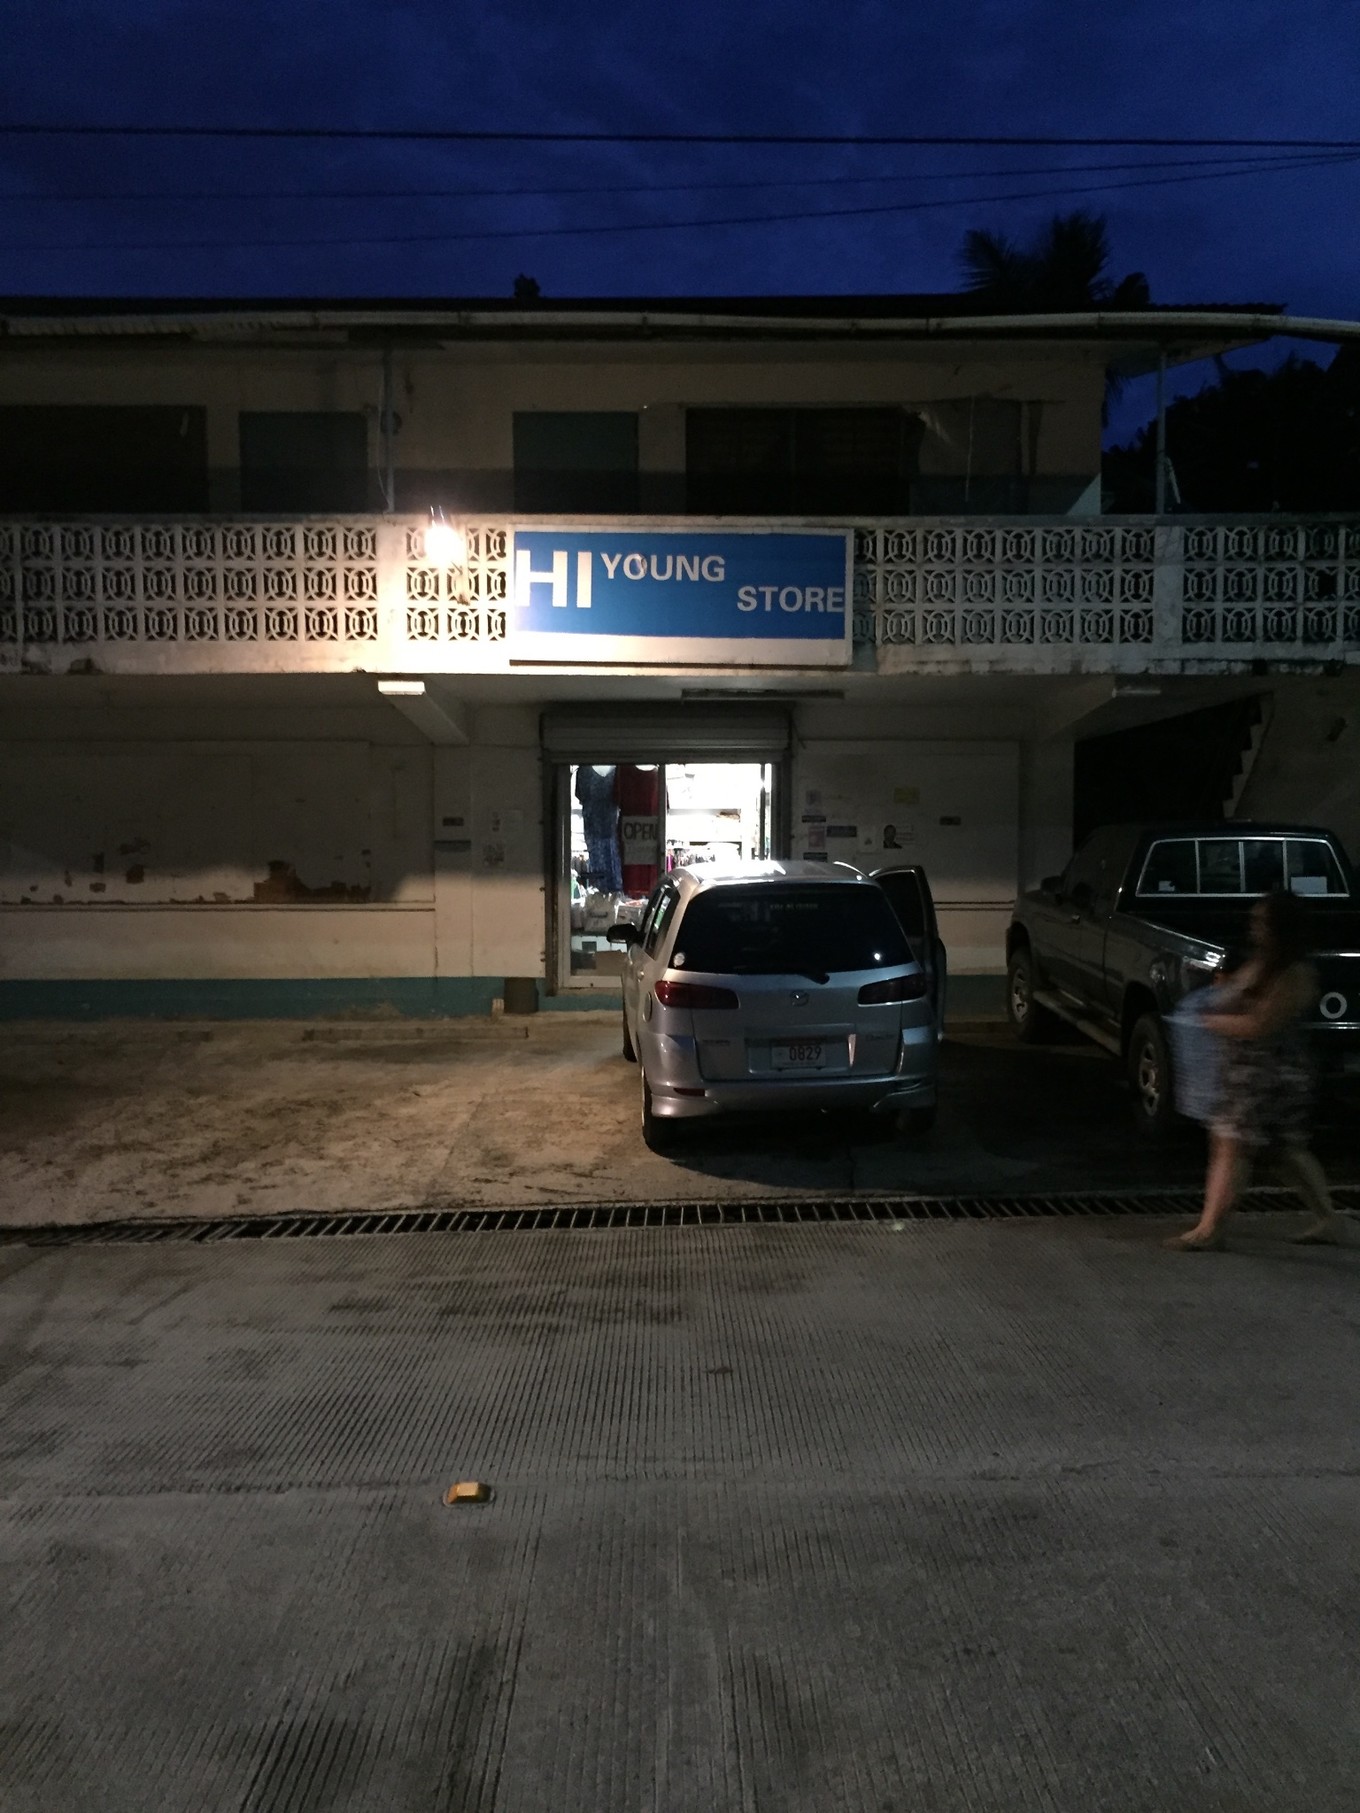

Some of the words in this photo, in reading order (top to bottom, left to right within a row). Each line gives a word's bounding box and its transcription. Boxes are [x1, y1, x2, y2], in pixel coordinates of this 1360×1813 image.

[515, 549, 592, 608] HI
[600, 553, 725, 582] YOUNG
[737, 586, 845, 613] STORE
[625, 822, 657, 840] OPEN
[789, 1045, 821, 1061] 0829
